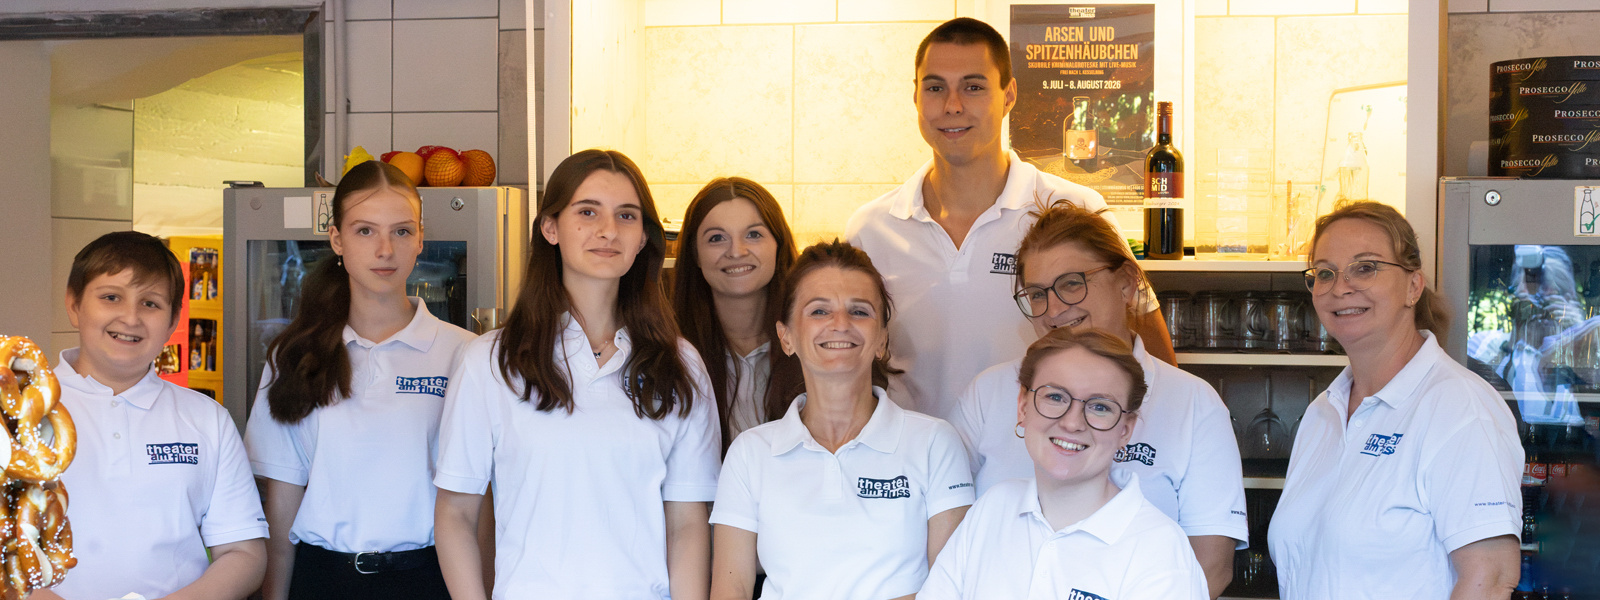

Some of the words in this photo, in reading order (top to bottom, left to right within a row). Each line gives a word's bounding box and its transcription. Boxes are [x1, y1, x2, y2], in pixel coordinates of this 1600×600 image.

[1045, 26, 1084, 42] ARSEN
[1089, 26, 1115, 42] UND
[1026, 42, 1138, 60] SPITZENHÄUBCHEN
[1496, 63, 1531, 73] PROSECCO
[1042, 80, 1049, 89] 9.
[1050, 81, 1063, 89] JULI
[1069, 80, 1076, 89] 8.
[1077, 80, 1103, 89] AUGUST
[1104, 81, 1121, 89] 2026
[1520, 86, 1568, 94] PROSECCO
[1532, 134, 1584, 142] PROSECCO
[1501, 160, 1540, 168] PROSECCO
[993, 262, 1010, 271] am
[397, 376, 448, 388] theater
[418, 384, 446, 397] fluss
[147, 444, 198, 455] theater
[151, 453, 169, 461] am
[171, 452, 198, 464] fluss
[858, 478, 909, 491] theater
[859, 488, 878, 496] am
[880, 488, 910, 499] fluss
